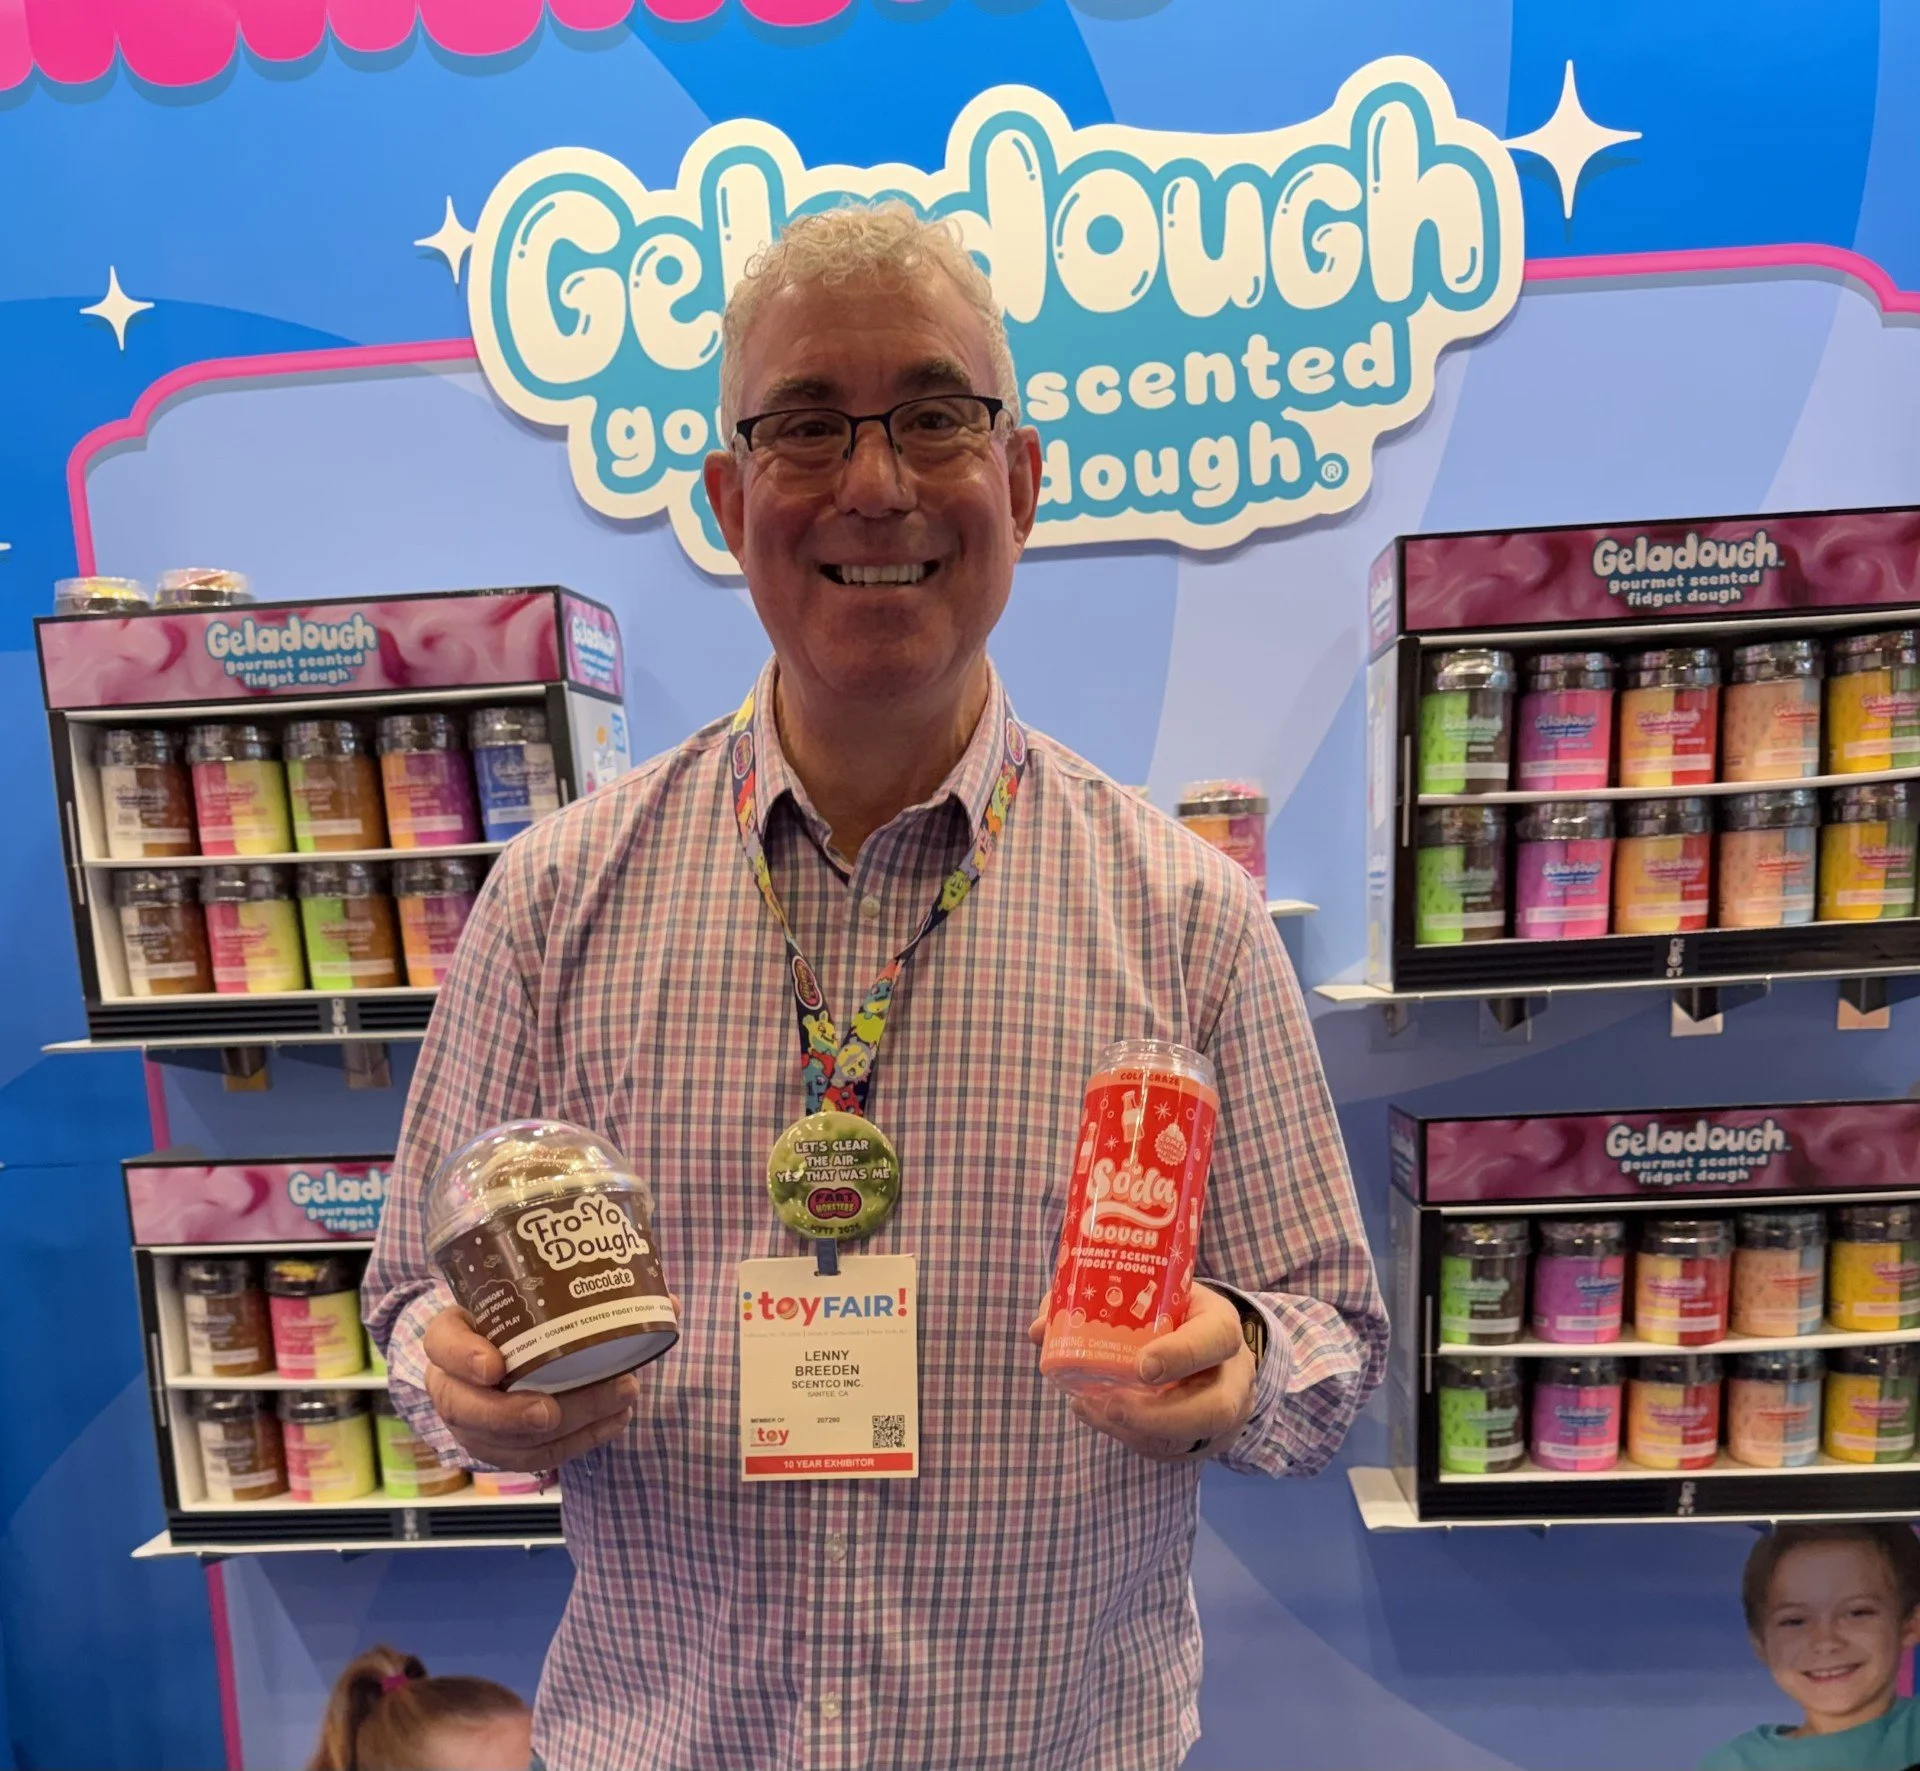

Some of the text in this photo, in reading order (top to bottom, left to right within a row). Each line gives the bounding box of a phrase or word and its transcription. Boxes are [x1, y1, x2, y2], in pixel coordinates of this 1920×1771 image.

[1026, 321, 1396, 421] scented
[1593, 532, 1777, 577] Geladough
[1609, 570, 1761, 594] gourmet scented
[1627, 587, 1742, 607] fidget dough
[207, 614, 377, 658] Geladough
[226, 652, 364, 675] gourmet scented
[244, 668, 349, 688] fidget dough
[795, 1138, 869, 1154] LET'S CLEAR
[1606, 1118, 1785, 1158] Geladough
[806, 1155, 859, 1167] THE AIR-
[1621, 1153, 1769, 1174] gourmet scented
[776, 1167, 891, 1183] YES THAT WAS ME
[1087, 1157, 1176, 1206] Soda
[1638, 1167, 1750, 1186] fidget dough
[289, 1168, 392, 1205] Gelad
[815, 1192, 853, 1203] FART
[306, 1204, 375, 1220] gourmet
[815, 1203, 855, 1214] MONSTERS
[325, 1217, 375, 1232] fidget
[523, 1199, 621, 1243] Fro-Yo
[543, 1221, 640, 1264] Dough
[1092, 1224, 1159, 1246] DOUGH
[1070, 1246, 1169, 1267] GOURMET SCENTED
[1077, 1257, 1156, 1276] FIDGET DOUGH
[573, 1271, 632, 1295] chocolate
[478, 1288, 505, 1309] SENSORY
[489, 1295, 515, 1313] DOUGH
[504, 1314, 521, 1328] PLAY
[515, 1338, 538, 1354] DOUGH
[544, 1321, 579, 1339] GOURMET
[579, 1310, 611, 1326] SCENTED
[611, 1306, 634, 1317] FIDGET
[634, 1304, 655, 1313] DOUGH
[804, 1350, 850, 1362] LENNY
[795, 1364, 860, 1377] BREEDEN
[791, 1378, 864, 1389] SCENTCO INC.
[757, 1427, 790, 1446] toy
[783, 1458, 875, 1469] 10 YEAR EXHIBITOR
